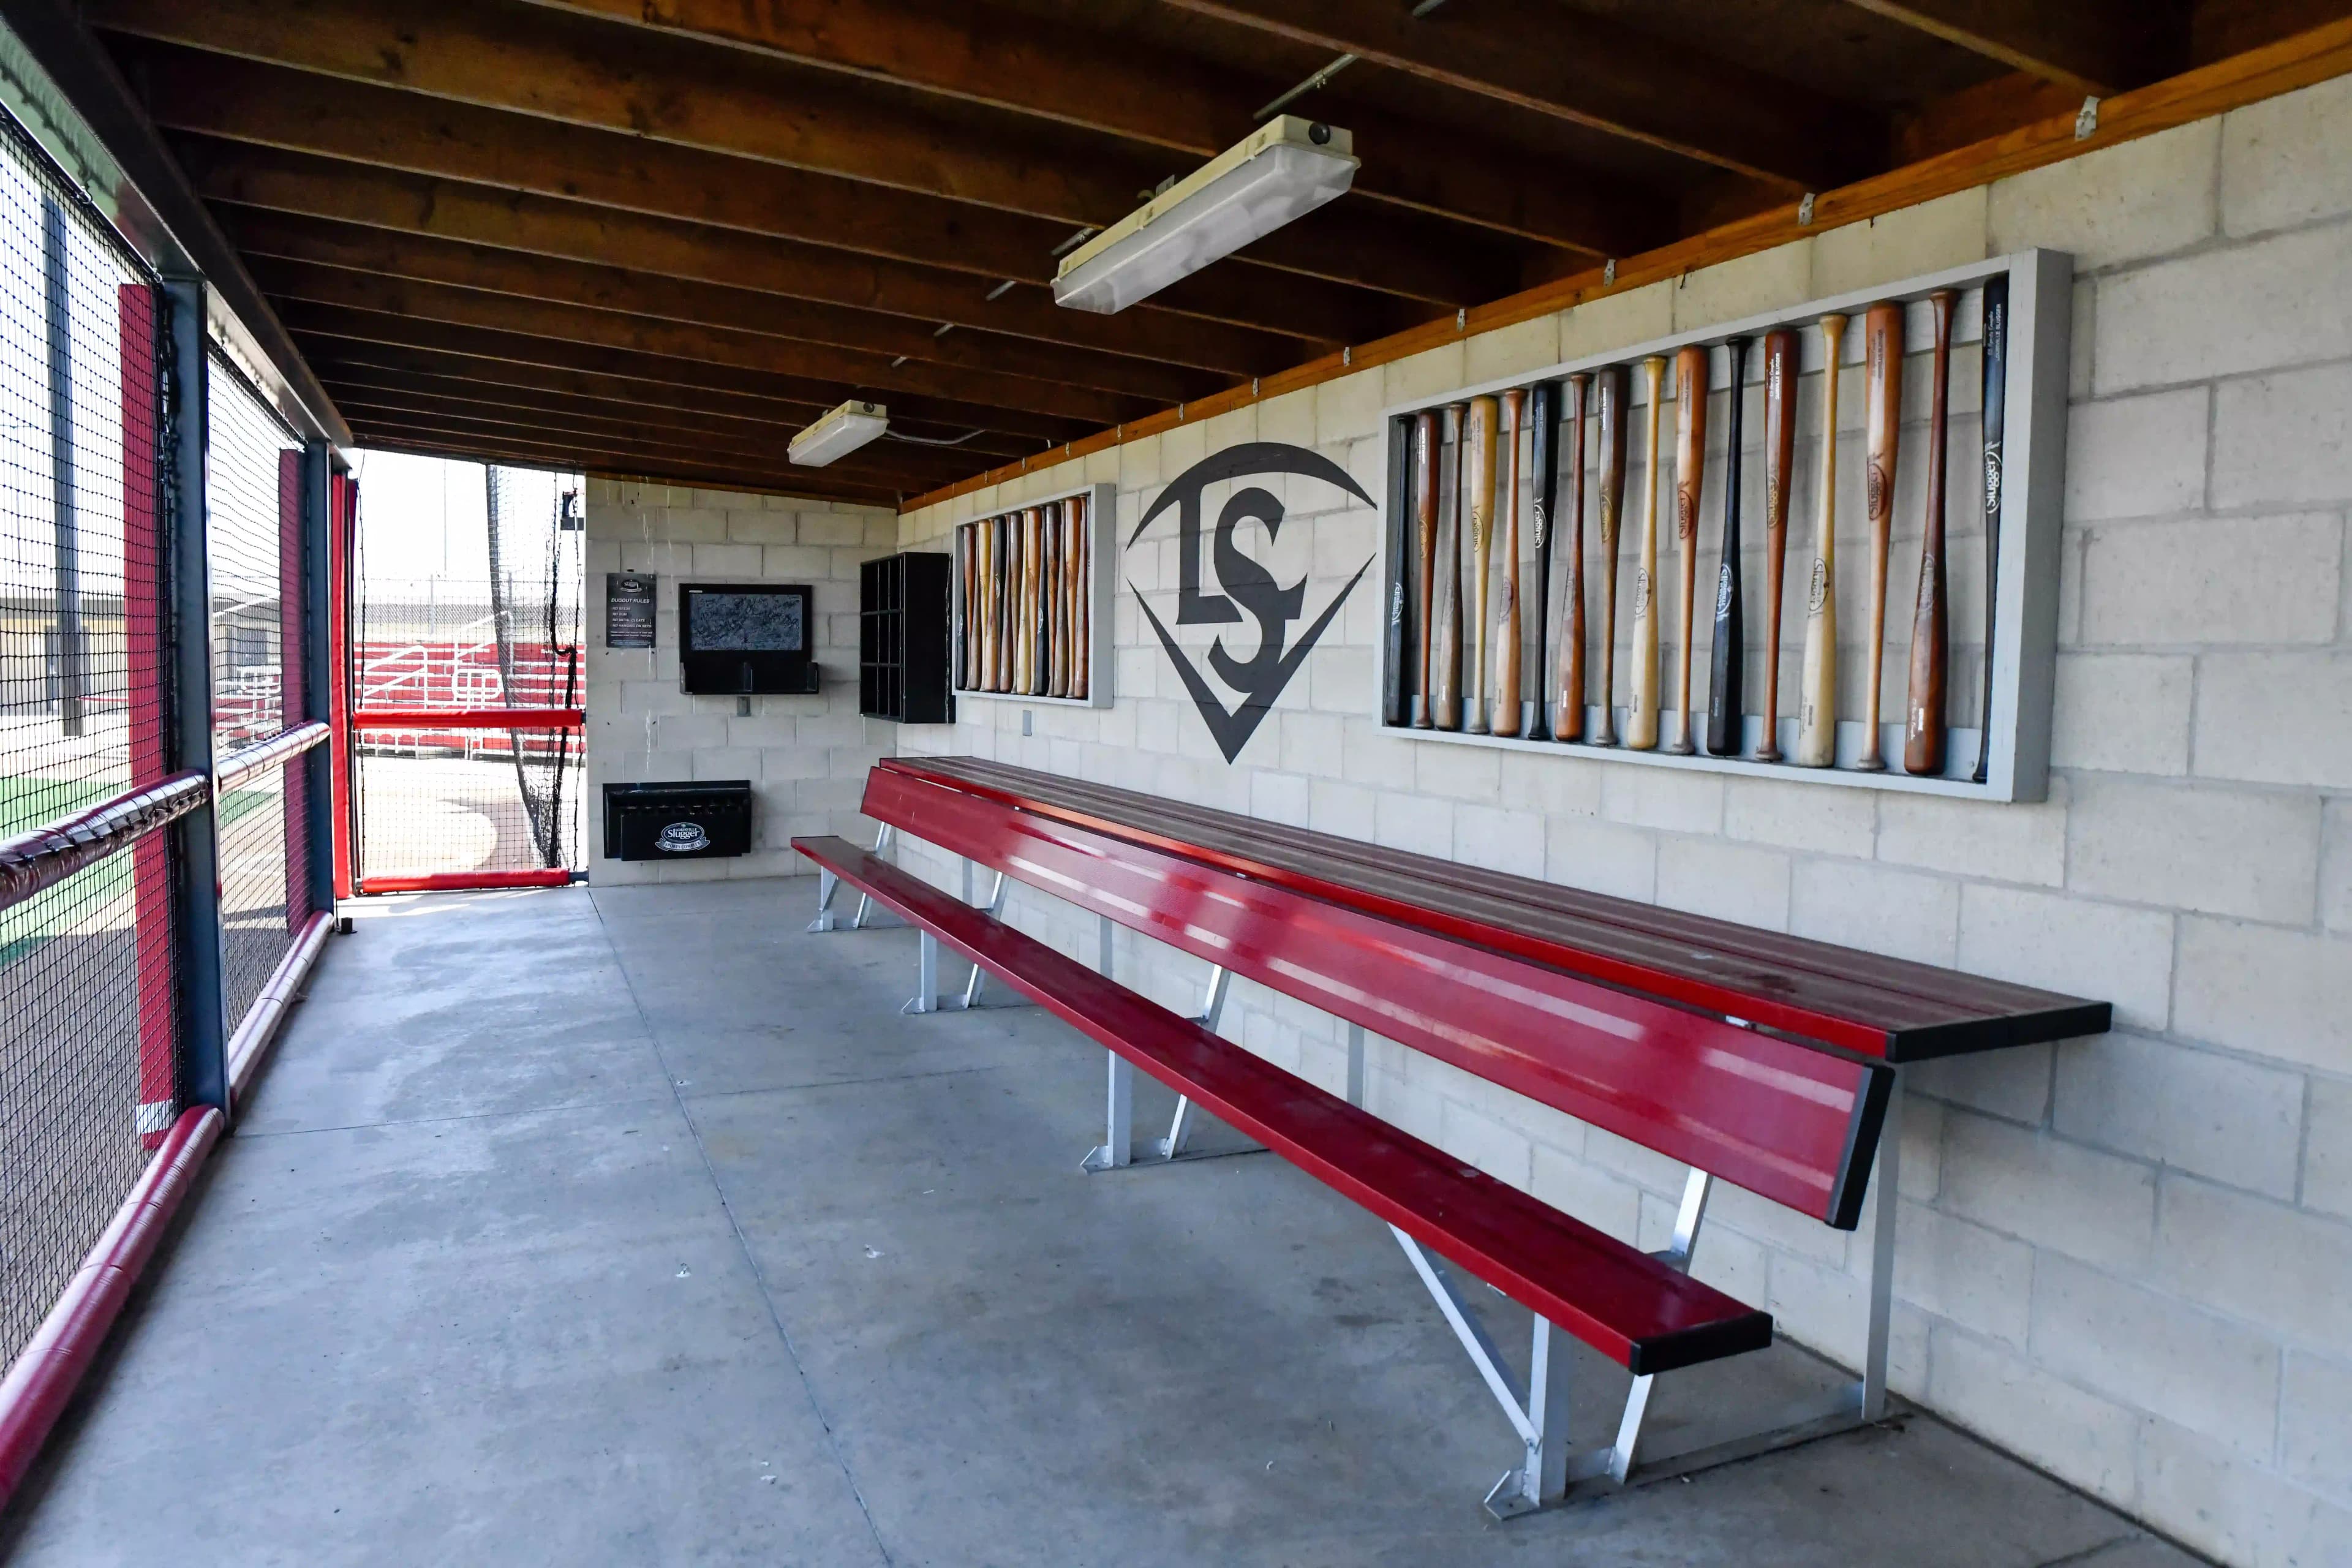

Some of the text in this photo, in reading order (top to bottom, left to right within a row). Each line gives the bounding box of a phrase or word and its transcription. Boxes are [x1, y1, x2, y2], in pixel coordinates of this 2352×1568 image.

[1985, 457, 2000, 507] Slugger
[1534, 510, 1543, 544] Slugger
[668, 828, 700, 840] Slugger
